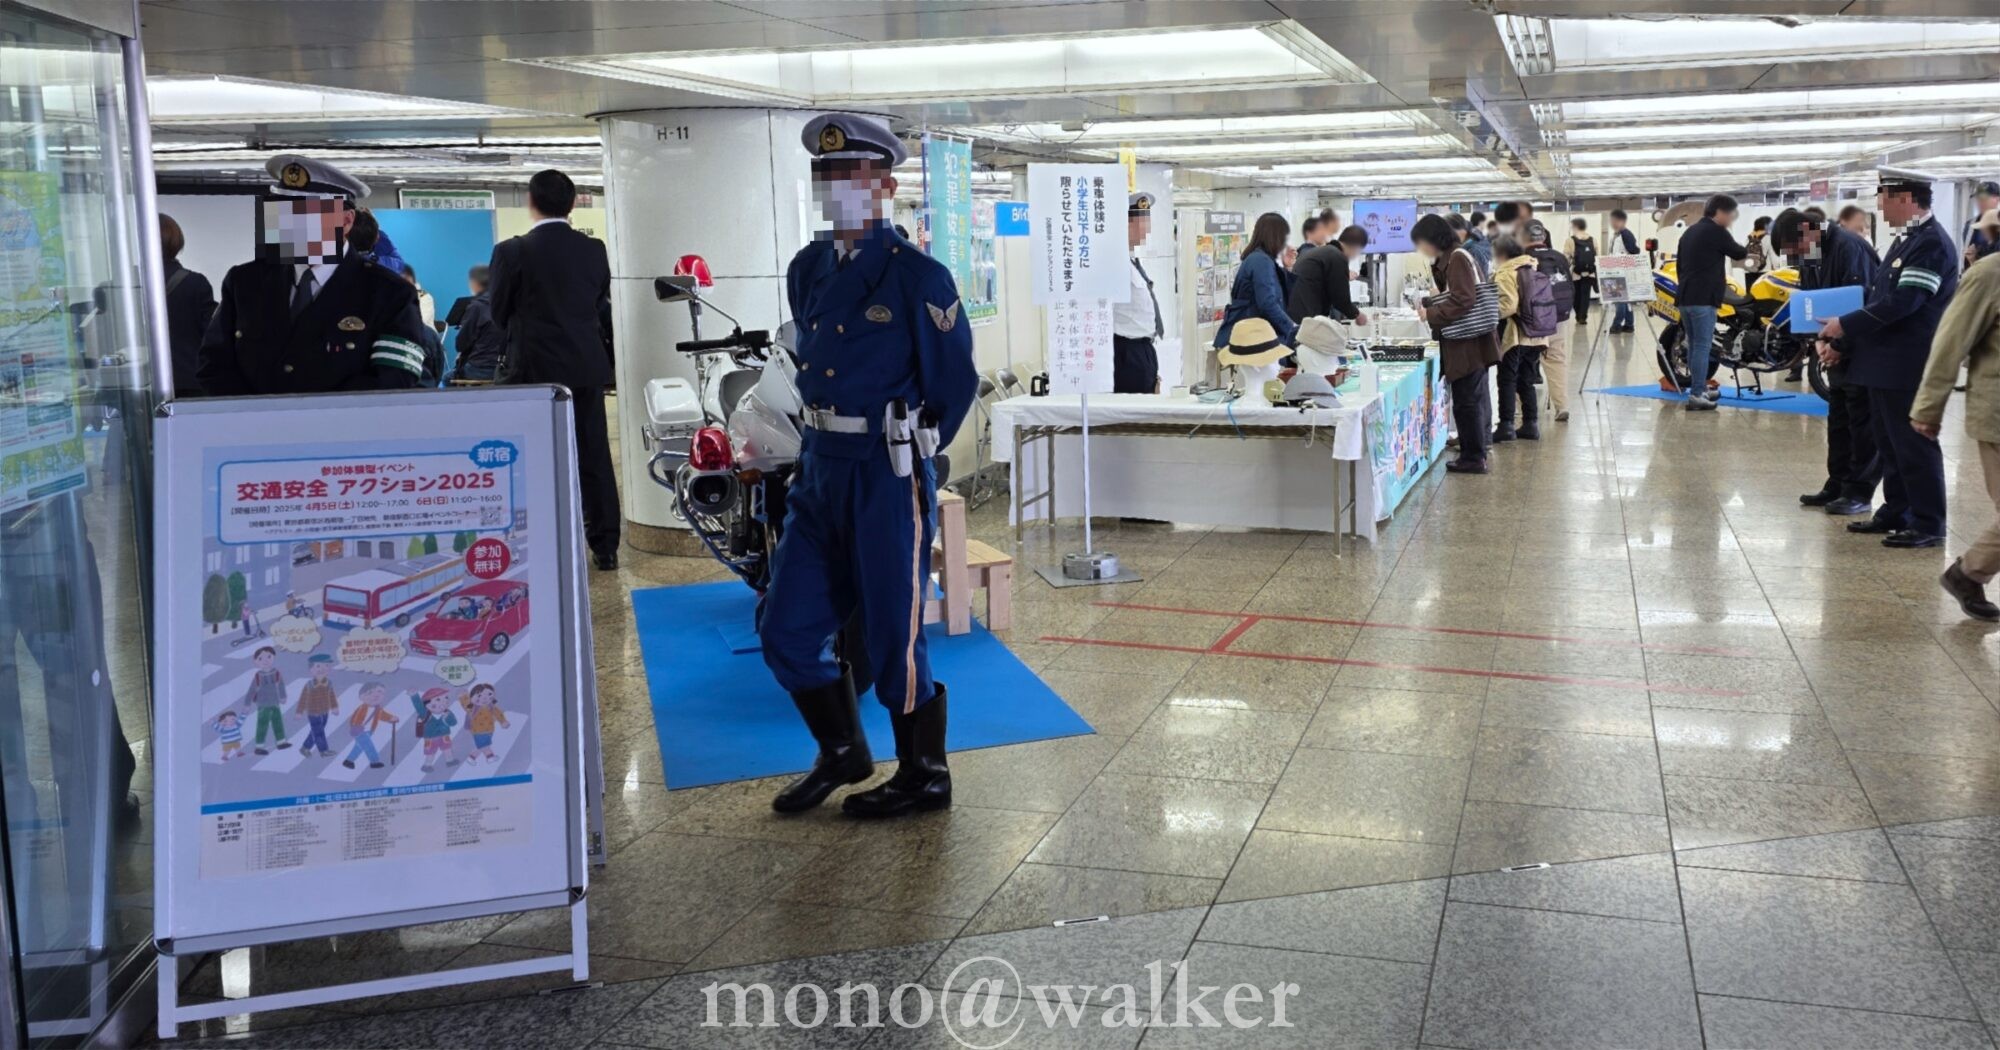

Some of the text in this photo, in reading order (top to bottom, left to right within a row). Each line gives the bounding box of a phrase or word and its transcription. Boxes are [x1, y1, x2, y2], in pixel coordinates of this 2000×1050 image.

[657, 126, 690, 141] H-11
[1093, 176, 1105, 234] 乗車体験は
[1077, 176, 1090, 268] 小学生以下の方に
[1060, 176, 1074, 291] 限らせていただきます
[1084, 311, 1094, 371] 不在の場合
[477, 447, 511, 462] 新宿
[321, 463, 415, 476] 参加体験型イベント
[237, 472, 495, 501] 交通安全 アクション2025
[474, 545, 502, 559] 参加
[474, 560, 502, 573] 無料
